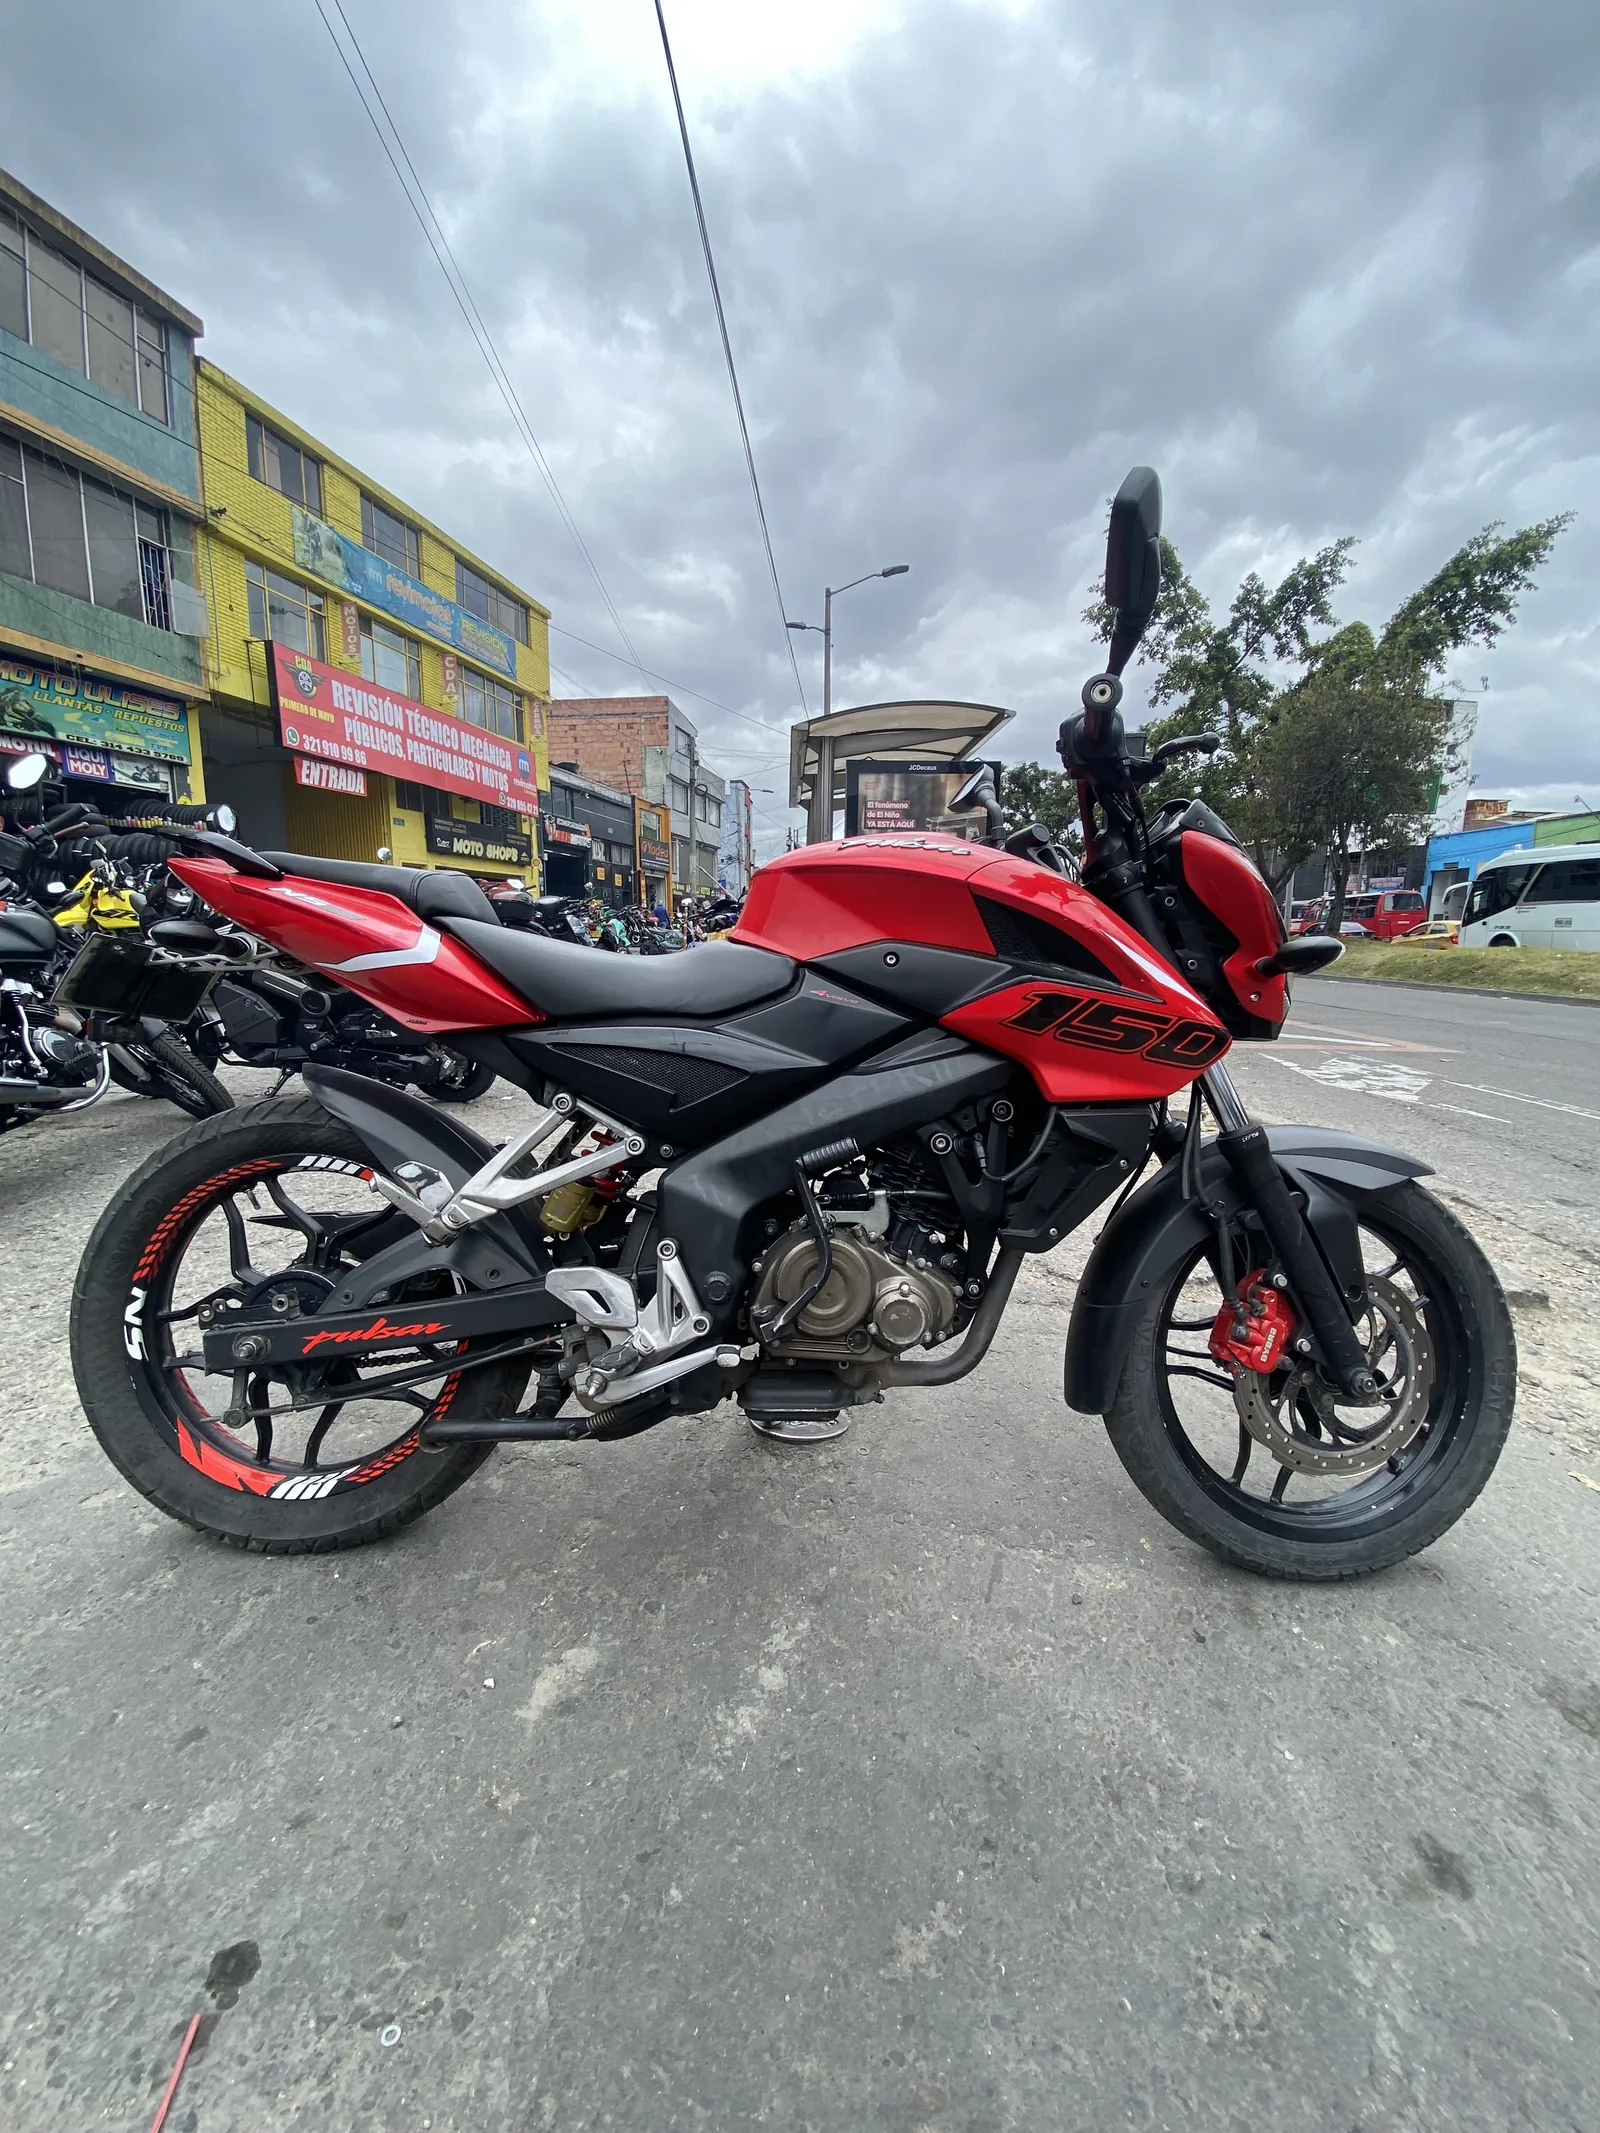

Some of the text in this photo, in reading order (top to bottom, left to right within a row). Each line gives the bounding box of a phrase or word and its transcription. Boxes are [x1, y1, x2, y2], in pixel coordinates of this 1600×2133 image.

[343, 606, 358, 653] MOTOS
[294, 655, 313, 673] CDA
[444, 656, 457, 693] CDA
[33, 690, 104, 714] LLANTAS
[114, 711, 186, 733] REPUESTOS
[83, 682, 180, 721] ULISES
[280, 696, 335, 724] PRIMERO DE MAYO
[331, 679, 512, 772] REVISIÓN TÉCNICO MECÁNICA
[533, 701, 542, 736] CARROS
[66, 734, 97, 746] CEL:
[101, 741, 123, 750] 314
[126, 746, 151, 756] 433
[153, 750, 185, 763] 5769
[68, 745, 105, 764] LIQUI
[302, 734, 367, 765] 321 910 99 86
[343, 715, 406, 761] PÚBLICOS,
[406, 738, 475, 782] PARTICULARES
[482, 765, 509, 793] MOTOS
[71, 759, 107, 778] MOLY
[301, 759, 365, 794] ENTRADA
[518, 757, 530, 773] rm
[513, 777, 537, 793] revimotos
[506, 796, 516, 811] 320
[874, 801, 909, 809] fenómeno
[866, 820, 915, 828] YA ESTÁ AQUÍ
[453, 837, 484, 857] MOTO
[647, 840, 669, 858] Yadea
[998, 990, 1233, 1070] 150
[123, 1286, 150, 1361] NS
[302, 1317, 452, 1355] pulsar
[1260, 1327, 1278, 1363] BYBRE
